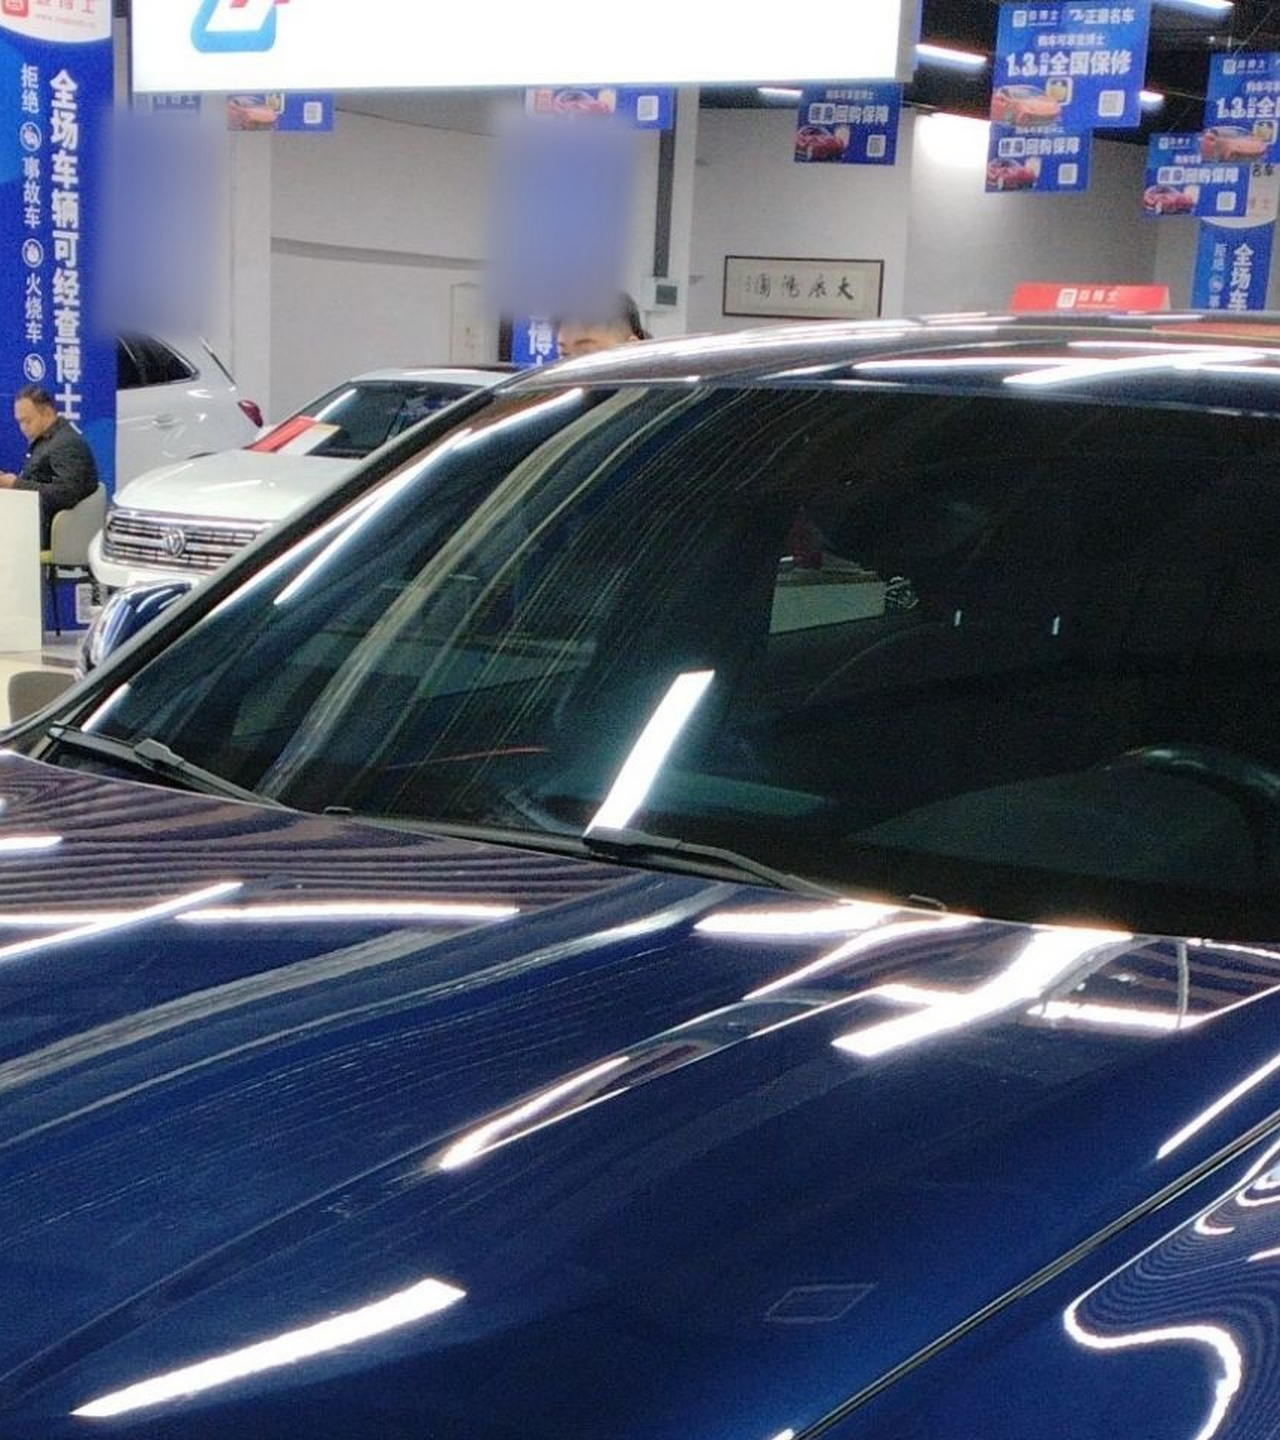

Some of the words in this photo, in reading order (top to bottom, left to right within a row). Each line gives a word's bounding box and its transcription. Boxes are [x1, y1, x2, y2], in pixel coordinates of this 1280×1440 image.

[22, 63, 40, 114] 拒绝
[22, 156, 42, 229] 事故车
[50, 69, 82, 434] 全场车辆可经查博士
[25, 273, 43, 344] 火烧车
